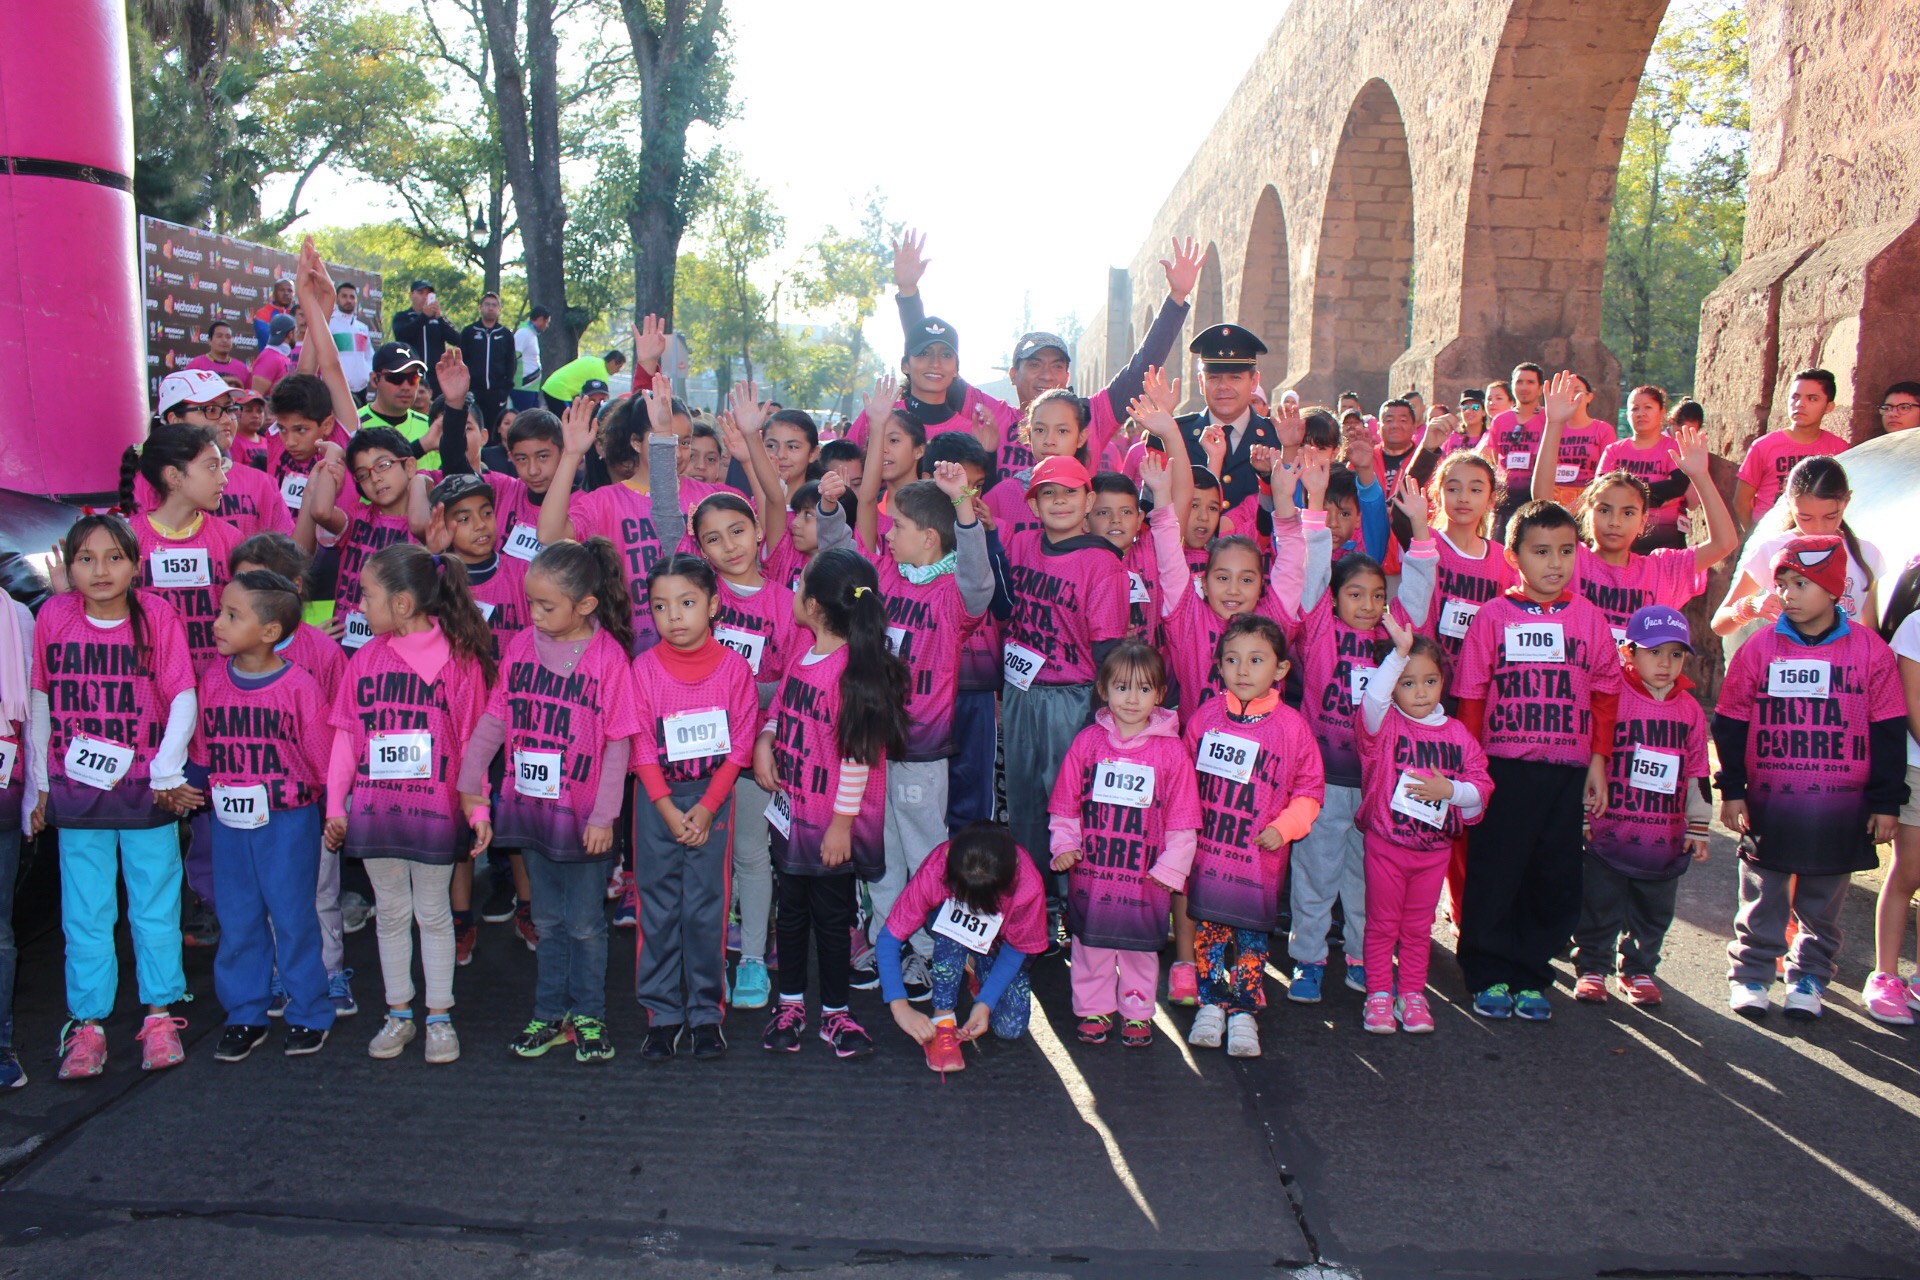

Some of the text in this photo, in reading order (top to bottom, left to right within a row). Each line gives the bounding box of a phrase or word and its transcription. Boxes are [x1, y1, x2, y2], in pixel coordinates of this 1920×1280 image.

[162, 558, 198, 573] 1537
[349, 620, 373, 637] 006
[1644, 615, 1664, 631] Juan
[1517, 632, 1554, 648] 1706
[1004, 651, 1034, 677] 2052
[1493, 668, 1577, 702] TROTA,
[1779, 668, 1821, 684] 1560
[1488, 703, 1574, 734] CORRE
[1756, 697, 1850, 730] TROTA,
[676, 723, 717, 744] 0197
[1555, 737, 1578, 747] 2016
[378, 745, 421, 764] 1580
[1208, 742, 1247, 766] 1538
[1756, 730, 1866, 761] CORRE II
[76, 748, 119, 775] 2176
[1633, 758, 1668, 779] 1557
[1756, 760, 1851, 773] MICHOACÁN 2016
[520, 762, 549, 782] 1579
[1104, 771, 1146, 792] 0132
[406, 784, 436, 796] 2016
[897, 784, 922, 804] 19
[222, 796, 255, 814] 2177
[1225, 850, 1253, 864] 2016
[1117, 873, 1145, 885] 2016
[949, 909, 989, 937] 0131
